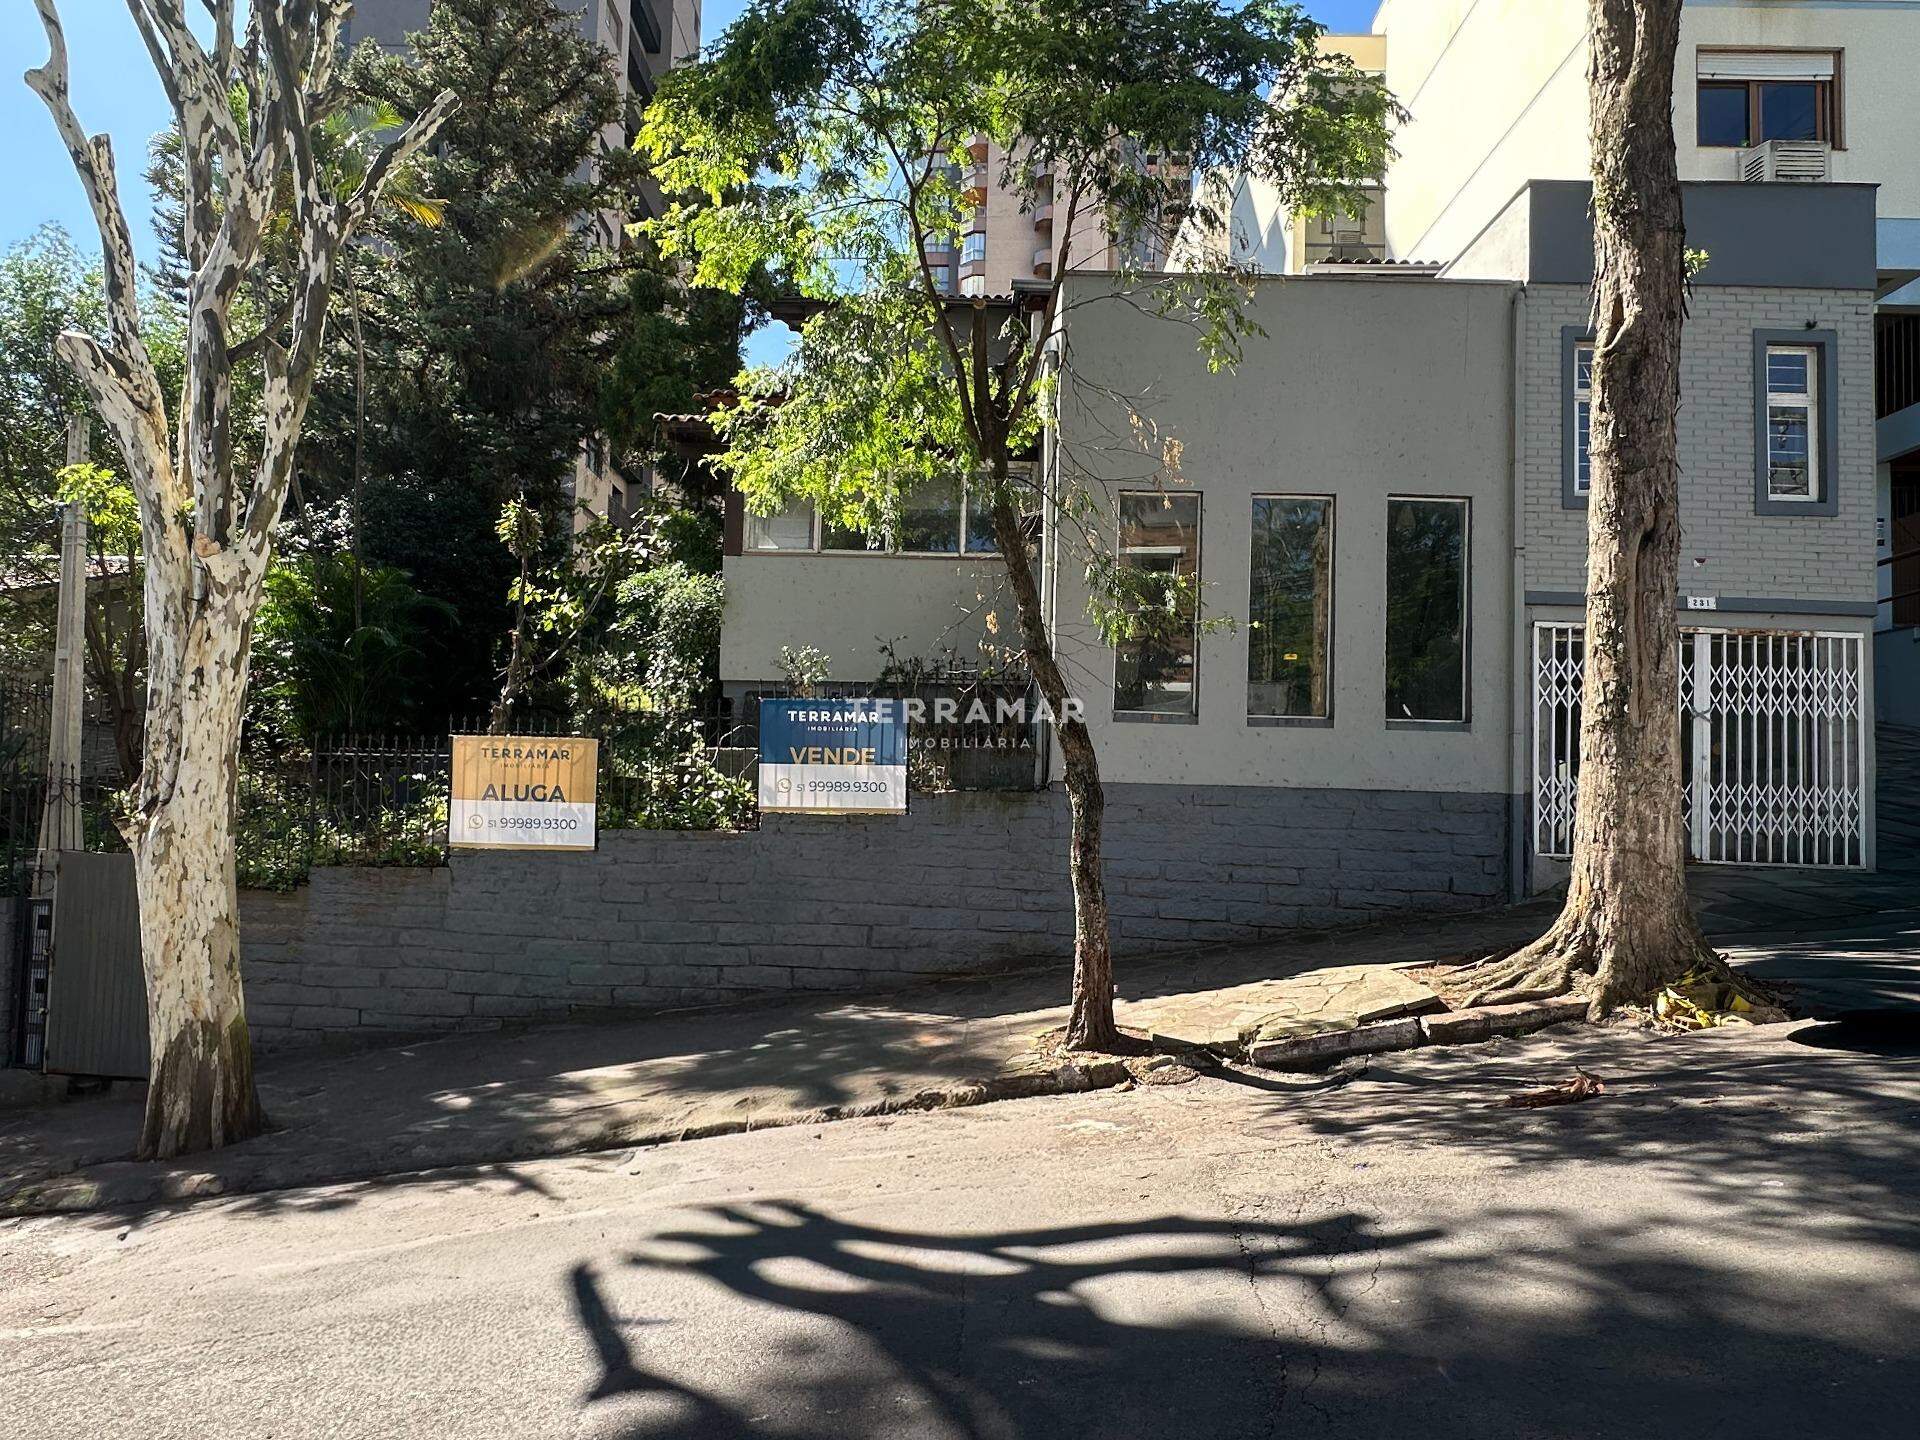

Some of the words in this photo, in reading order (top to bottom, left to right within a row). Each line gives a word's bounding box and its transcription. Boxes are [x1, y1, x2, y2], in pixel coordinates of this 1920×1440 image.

[1692, 599, 1710, 607] 231
[787, 710, 879, 723] TERRAMAR
[481, 747, 570, 760] TERRAMAR
[789, 746, 876, 765] VENDE
[481, 783, 566, 803] ALUGA
[809, 780, 887, 793] 99989.9300
[487, 819, 497, 828] 51
[500, 817, 577, 830] 99989.9300
